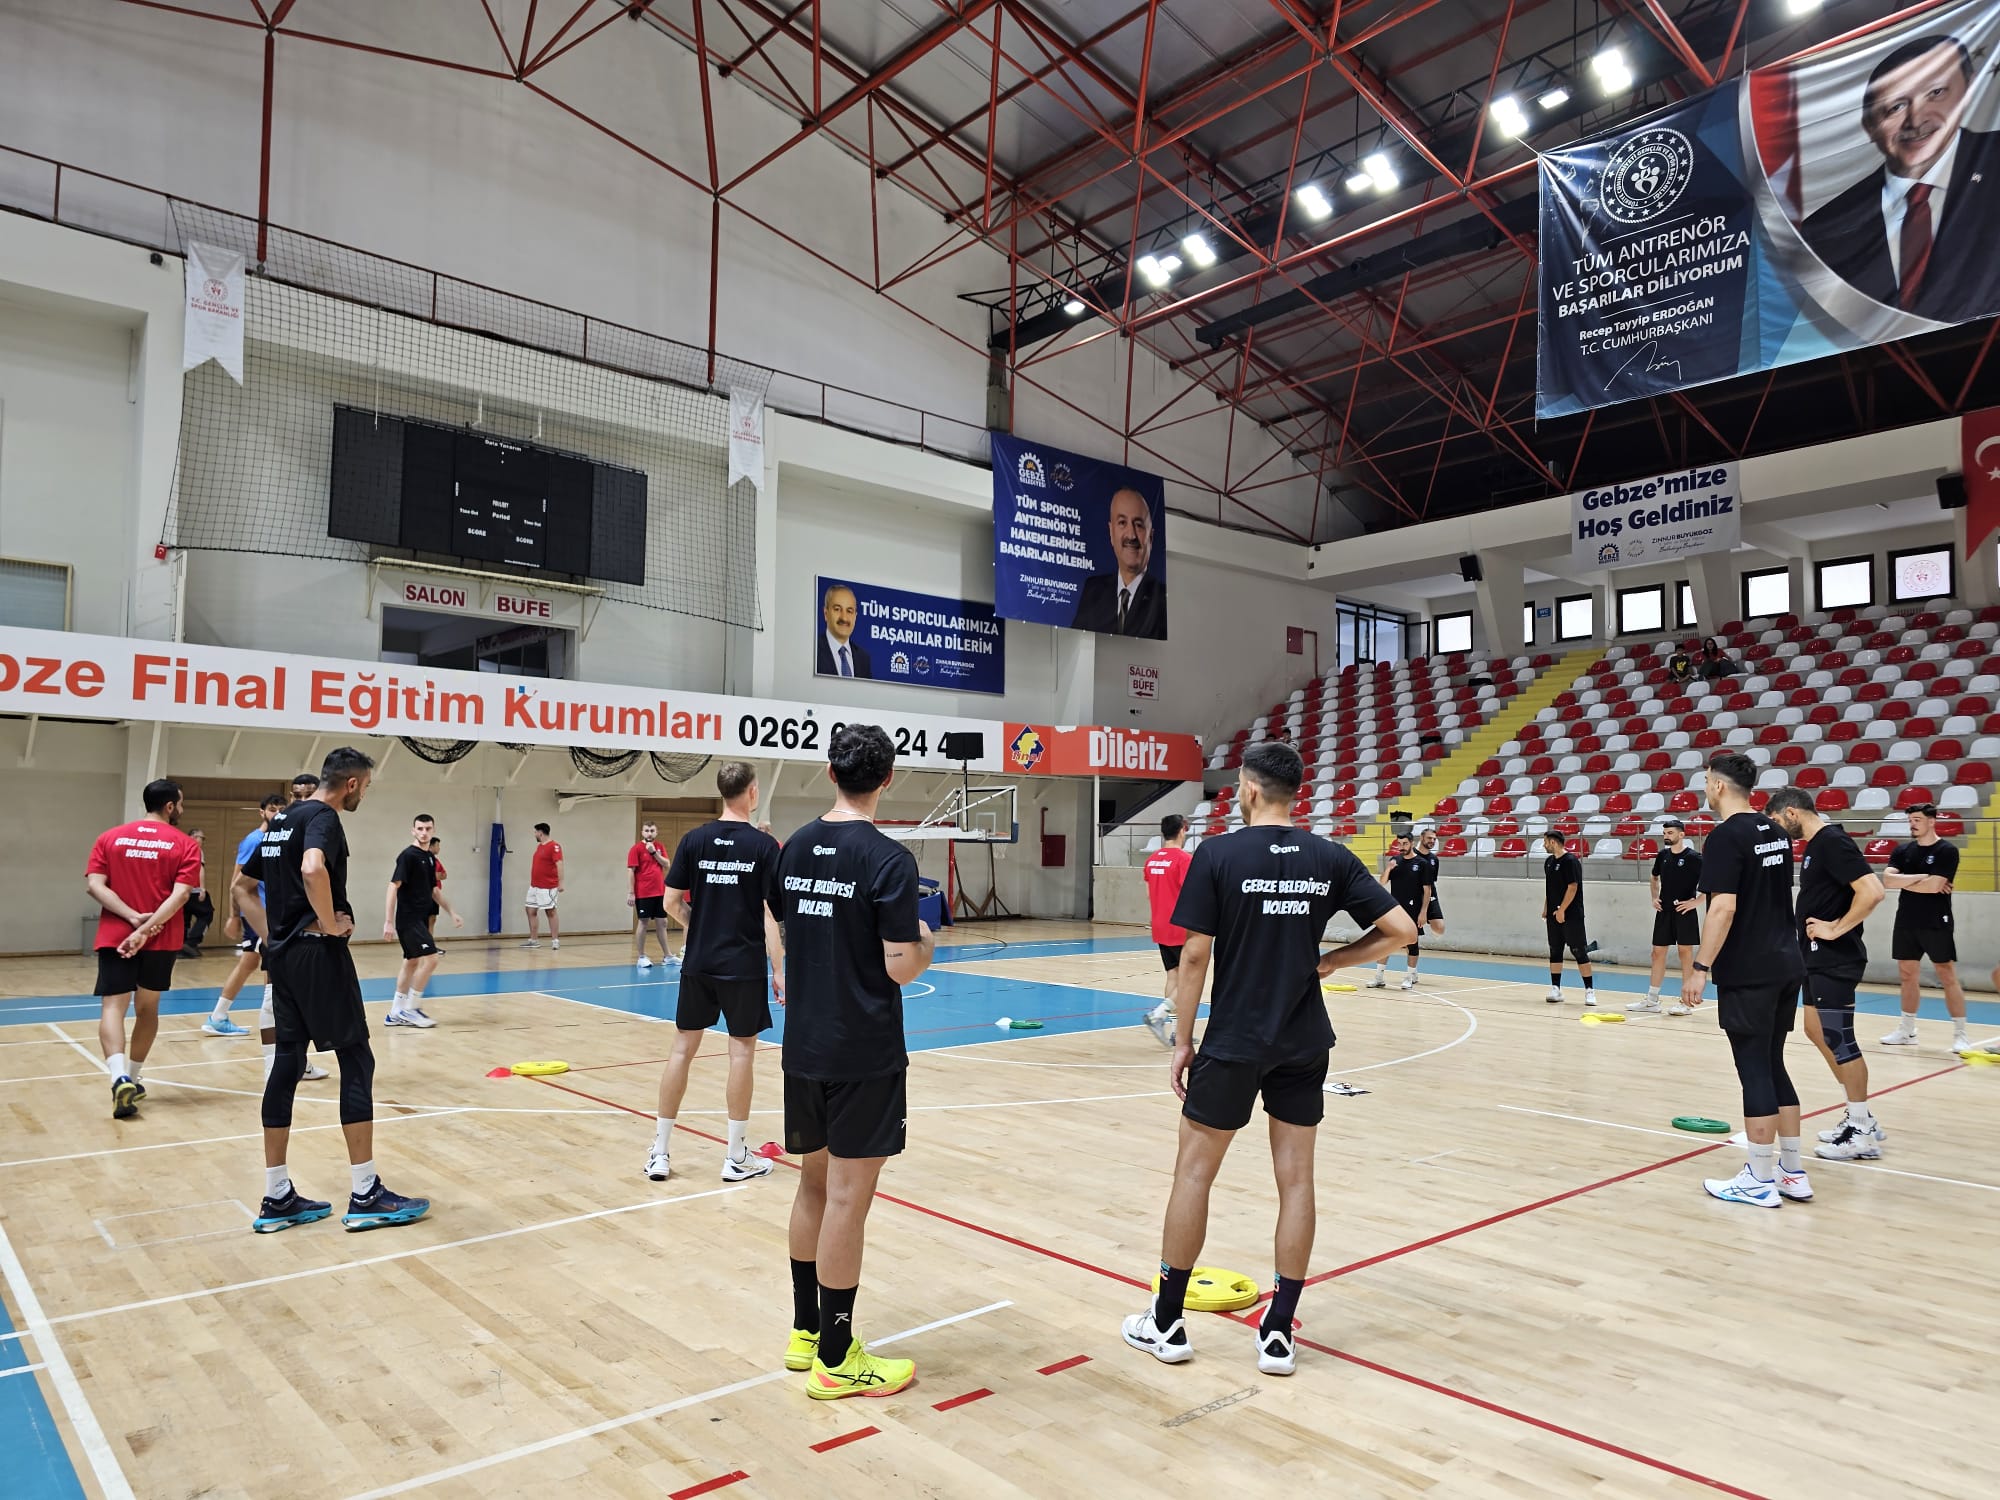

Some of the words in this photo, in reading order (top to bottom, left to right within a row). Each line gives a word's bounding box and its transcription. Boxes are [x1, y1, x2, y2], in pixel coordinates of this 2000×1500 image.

[1573, 251, 1613, 275] TÜM
[1618, 215, 1726, 263] ANTRENÖR
[1553, 282, 1573, 301] VE
[1579, 230, 1750, 294] SPORCULARIMIZA
[1558, 285, 1644, 318] BAŞARILAR
[1647, 254, 1742, 294] DİLİYORUM
[1579, 326, 1612, 341] Recep
[1652, 296, 1714, 322] ERDOĞAN
[1581, 343, 1599, 356] T.C.
[1602, 313, 1713, 349] CUMHURBAŞKANI
[1019, 469, 1045, 481] GEBZE
[1583, 468, 1727, 510] Gebze'mize
[1016, 494, 1038, 511] TÜM
[1040, 501, 1081, 521] SPORCU,
[1578, 517, 1623, 540] Hoş
[1628, 494, 1733, 530] Geldiniz
[1014, 510, 1067, 535] ANTRENÖR
[1069, 523, 1080, 536] VE
[1011, 527, 1086, 553] HAKEMLERİMİZE
[1000, 541, 1054, 564] BAŞARILAR
[1056, 552, 1095, 571] DİLERİM.
[405, 584, 465, 607] SALON
[497, 596, 550, 617] BÜFE
[861, 600, 890, 620] TÜM
[892, 606, 999, 636] SPORCULARIMIZA
[871, 625, 942, 646] BAŞARILAR
[945, 633, 992, 655] DİLERİM
[1129, 666, 1158, 679] SALON
[1133, 678, 1154, 691] BÜFE
[132, 653, 286, 711] Final
[310, 670, 484, 729] Eğitim
[504, 687, 722, 741] Kurumları
[738, 714, 819, 750] 0262
[895, 727, 927, 757] 24
[1089, 730, 1168, 771] Dileriz
[1241, 878, 1277, 893] GEBZE
[1278, 877, 1331, 896] BELEDİYESİ
